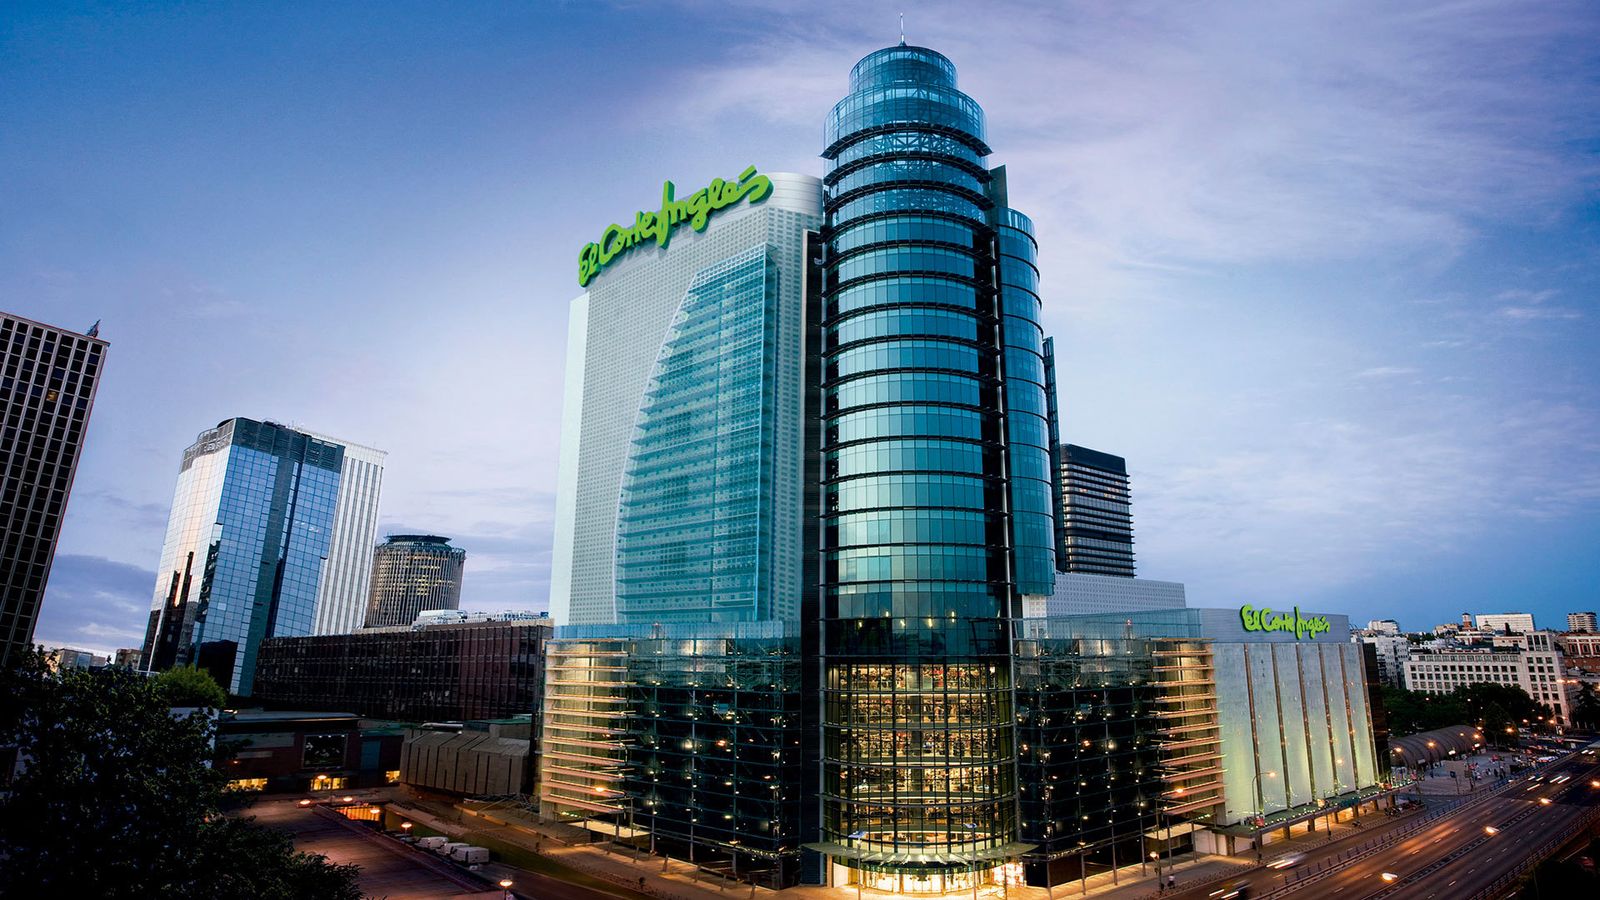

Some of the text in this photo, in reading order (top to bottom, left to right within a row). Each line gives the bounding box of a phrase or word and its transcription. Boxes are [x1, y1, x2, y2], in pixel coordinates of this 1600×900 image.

[578, 164, 774, 287] El Corte Inglés
[1240, 604, 1262, 632] El
[1260, 607, 1295, 632] Corte
